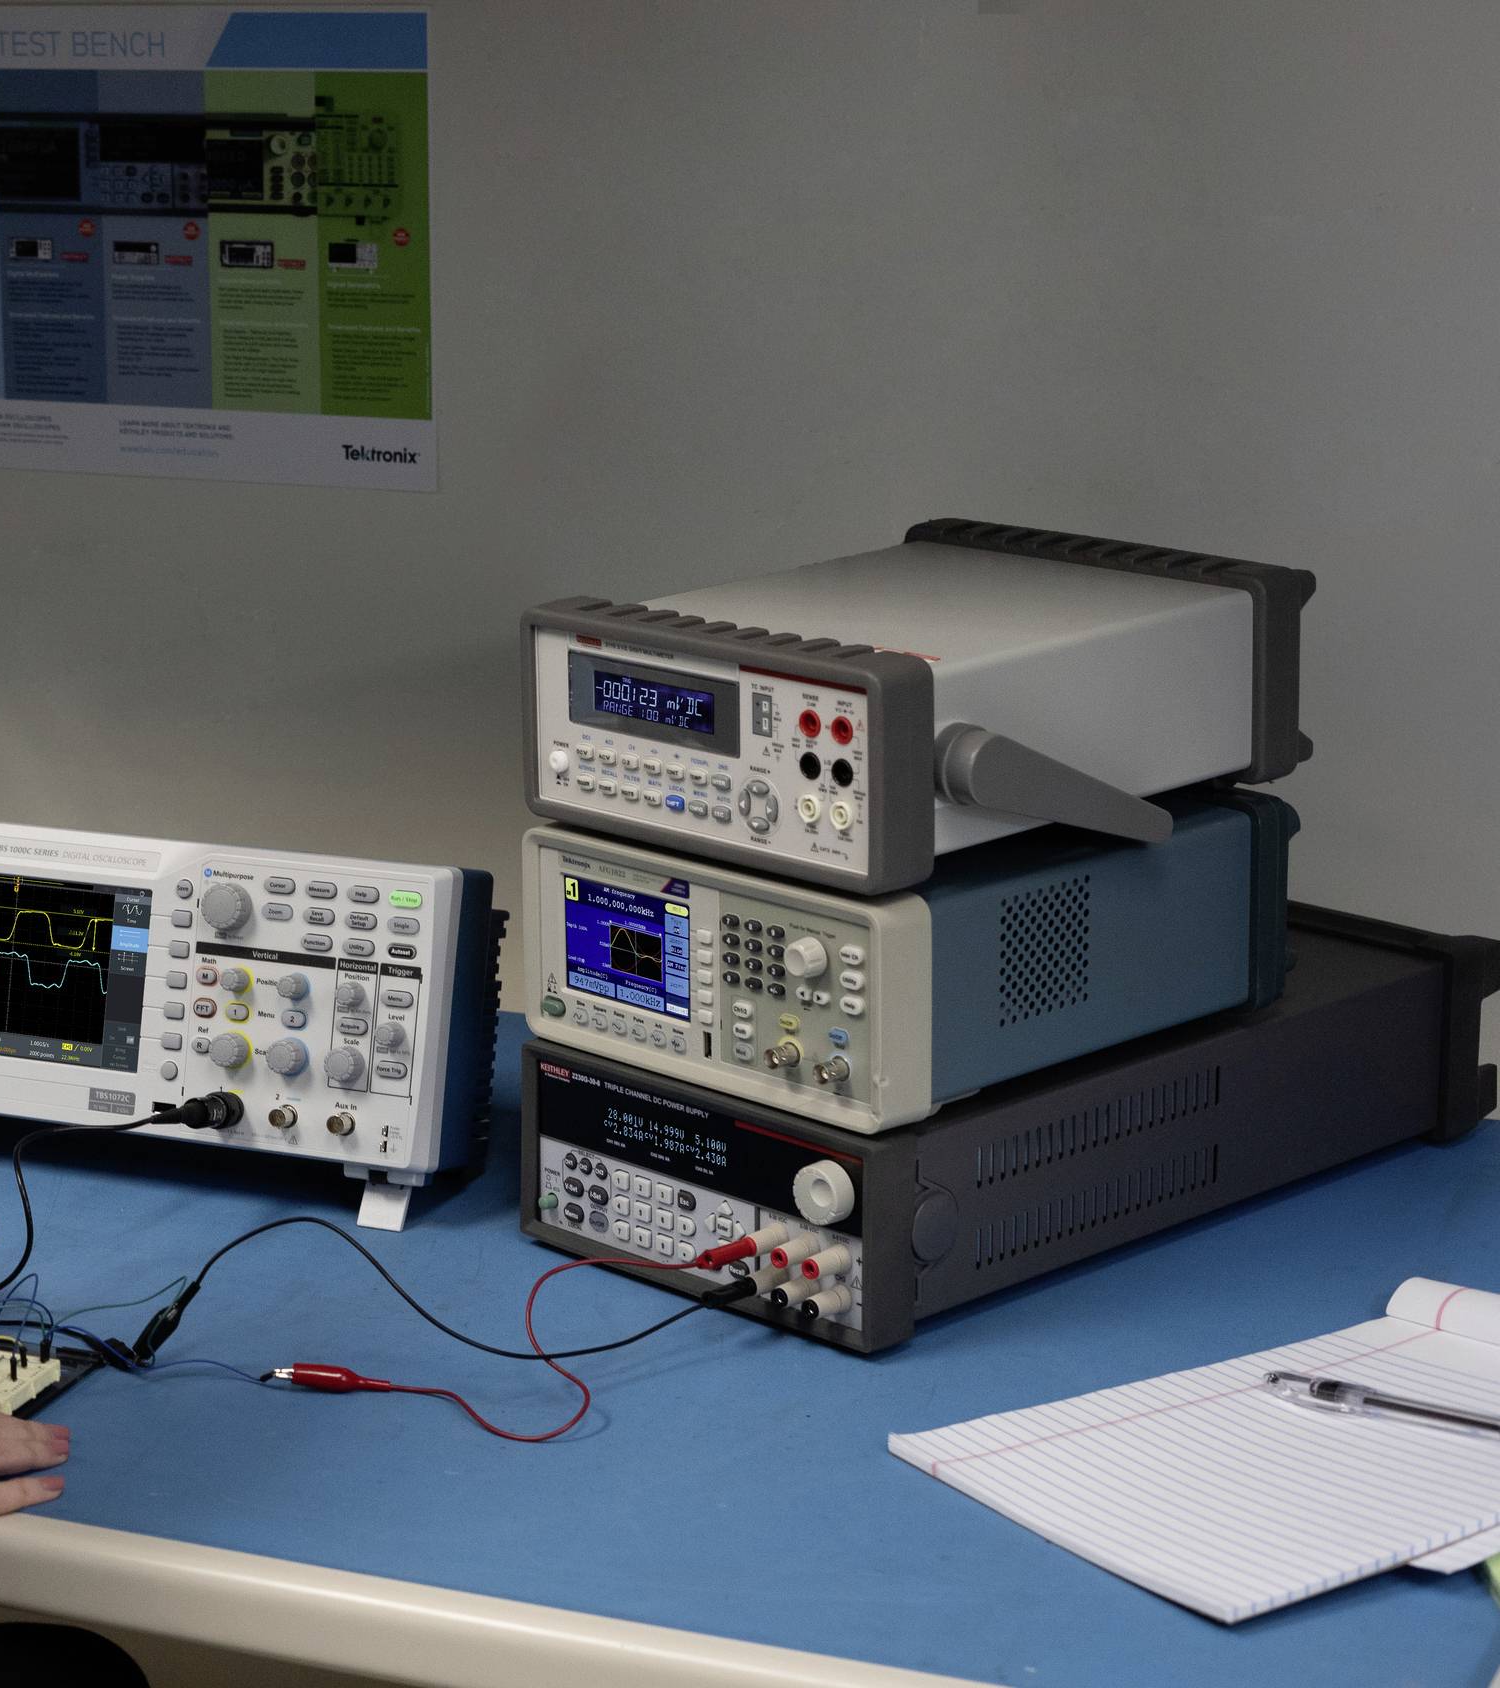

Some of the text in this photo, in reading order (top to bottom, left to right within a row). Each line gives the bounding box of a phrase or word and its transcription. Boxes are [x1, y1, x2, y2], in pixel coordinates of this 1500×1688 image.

[71, 31, 165, 57] BENCH
[341, 444, 419, 464] Tektronix
[603, 700, 634, 717] RANGE
[686, 697, 704, 717] DC
[9, 845, 33, 857] 1000C
[34, 848, 60, 859] SERIES
[62, 850, 92, 862] DIGITAL
[92, 854, 149, 868] OSCILLOSCOPE
[212, 870, 255, 882] Multipurpose
[269, 882, 287, 890] Cursor
[308, 885, 331, 893] Measure
[355, 891, 368, 899] Help
[611, 888, 636, 900] frequency
[351, 920, 368, 928] Setup
[303, 939, 327, 947] Function
[348, 943, 365, 952] Utility
[252, 950, 279, 961] Vertical
[391, 947, 412, 956] Autoset
[201, 957, 217, 965] Math
[340, 962, 377, 972] Horizontal
[388, 966, 414, 977] Trigger
[344, 973, 370, 981] Position
[256, 978, 278, 987] Positi
[573, 975, 610, 995] 947mVpp
[387, 995, 404, 1003] Menu
[620, 988, 661, 1008] 1.000kHz
[196, 1004, 210, 1012] FFT
[257, 1010, 275, 1018] Menu
[388, 1013, 406, 1021] Level
[197, 1026, 209, 1034] Ref
[340, 1022, 361, 1031] Acquire
[196, 1041, 203, 1050] R
[343, 1037, 360, 1046] Scale
[254, 1047, 269, 1056] Sca
[540, 1062, 570, 1078] KEITHLEY
[604, 1081, 624, 1094] TRIPLE
[625, 1088, 652, 1103] CHANNEL
[652, 1096, 662, 1105] DC
[663, 1098, 685, 1112] POWER
[685, 1105, 710, 1119] SUPPLY
[335, 1102, 349, 1110] Aux
[649, 1120, 685, 1140] 14.999V
[694, 1134, 727, 1153] 5.100V
[544, 1167, 561, 1177] POWER
[679, 1196, 690, 1206] Esc
[564, 1208, 579, 1220] Menu
